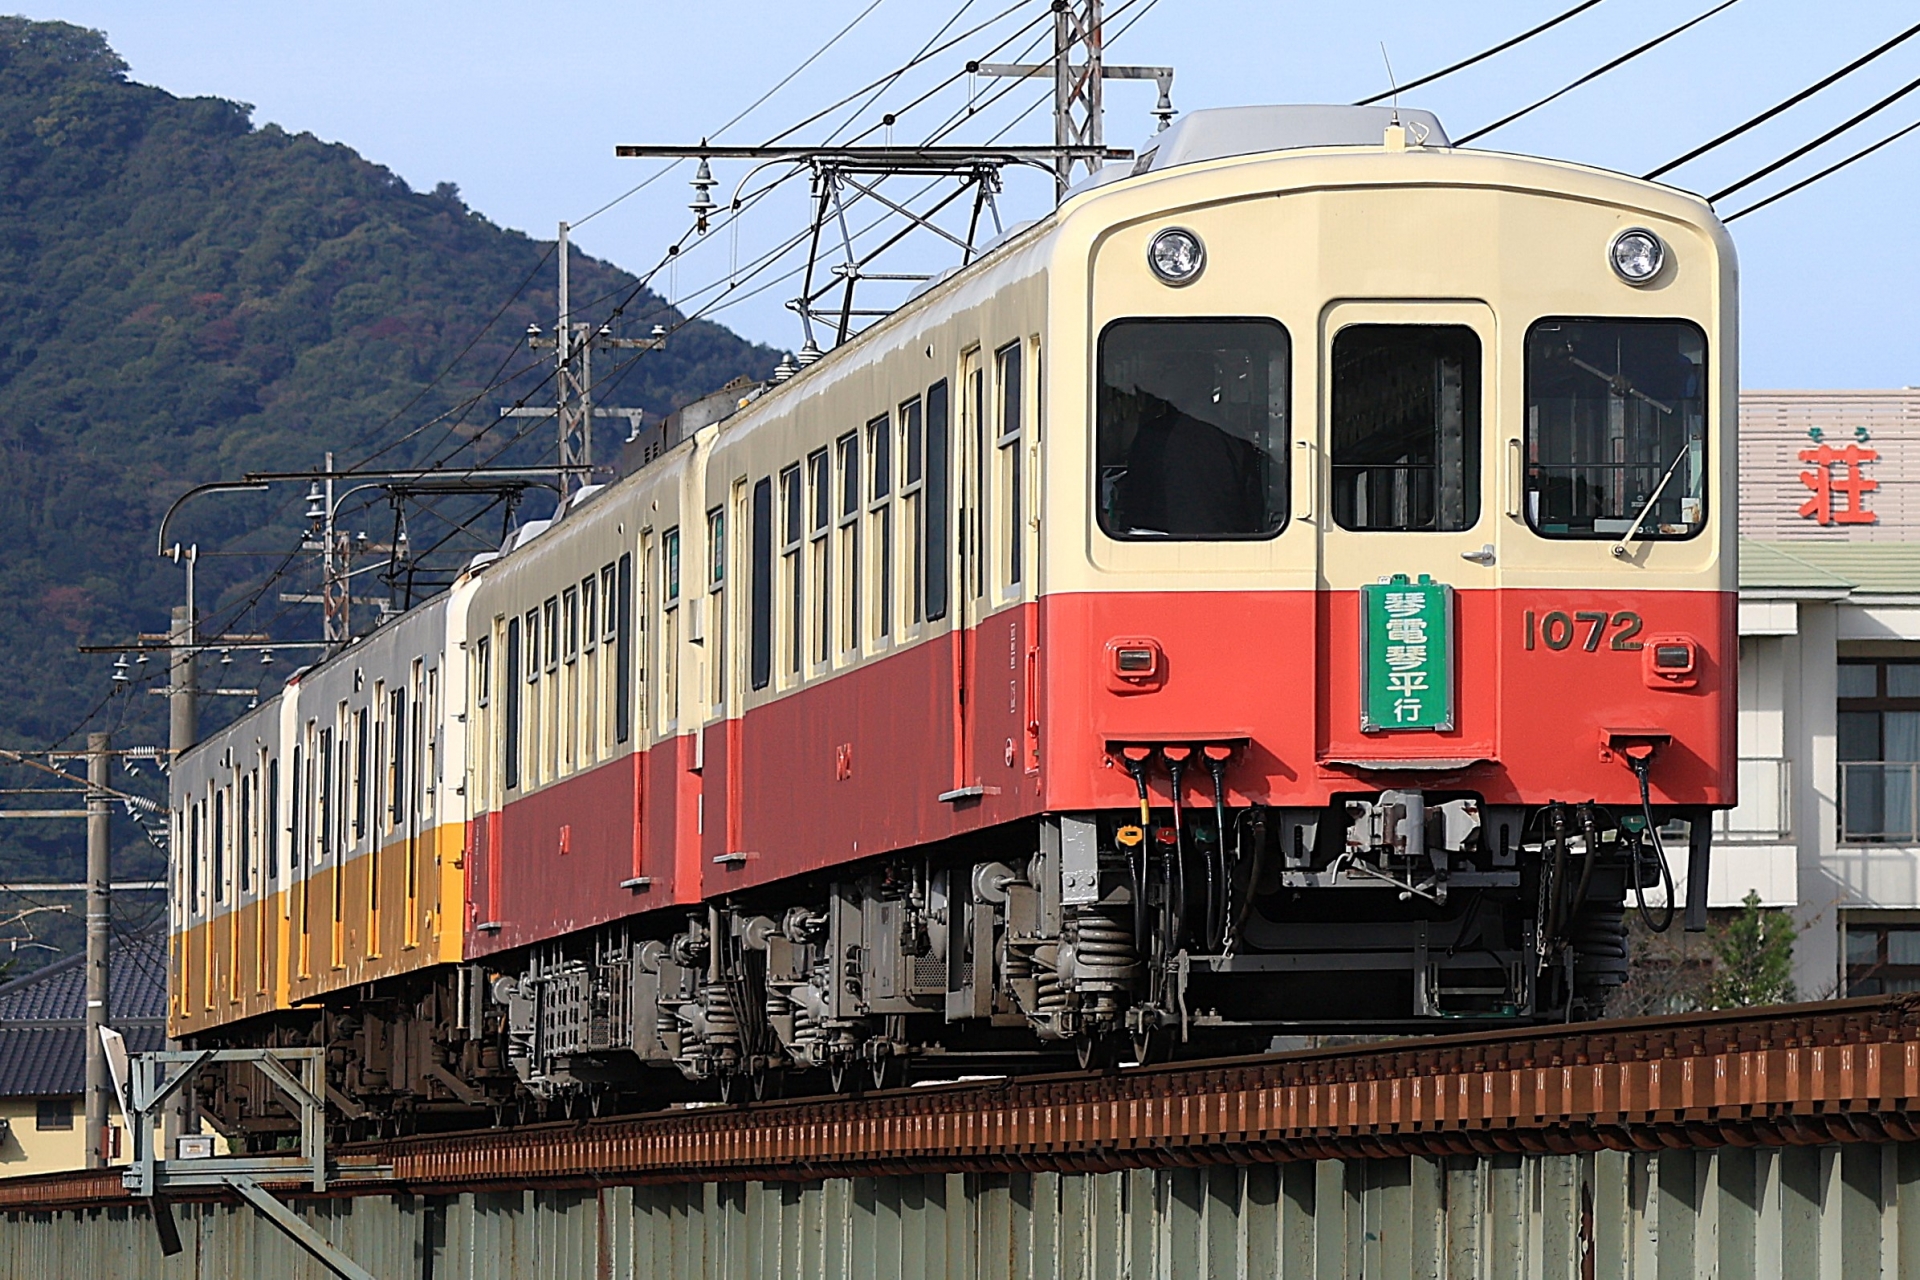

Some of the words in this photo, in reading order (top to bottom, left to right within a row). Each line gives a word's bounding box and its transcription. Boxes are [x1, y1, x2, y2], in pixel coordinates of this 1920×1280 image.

[1797, 444, 1878, 525] 荘
[1384, 592, 1429, 722] 琴電琴平行
[1523, 610, 1643, 651] 1072
